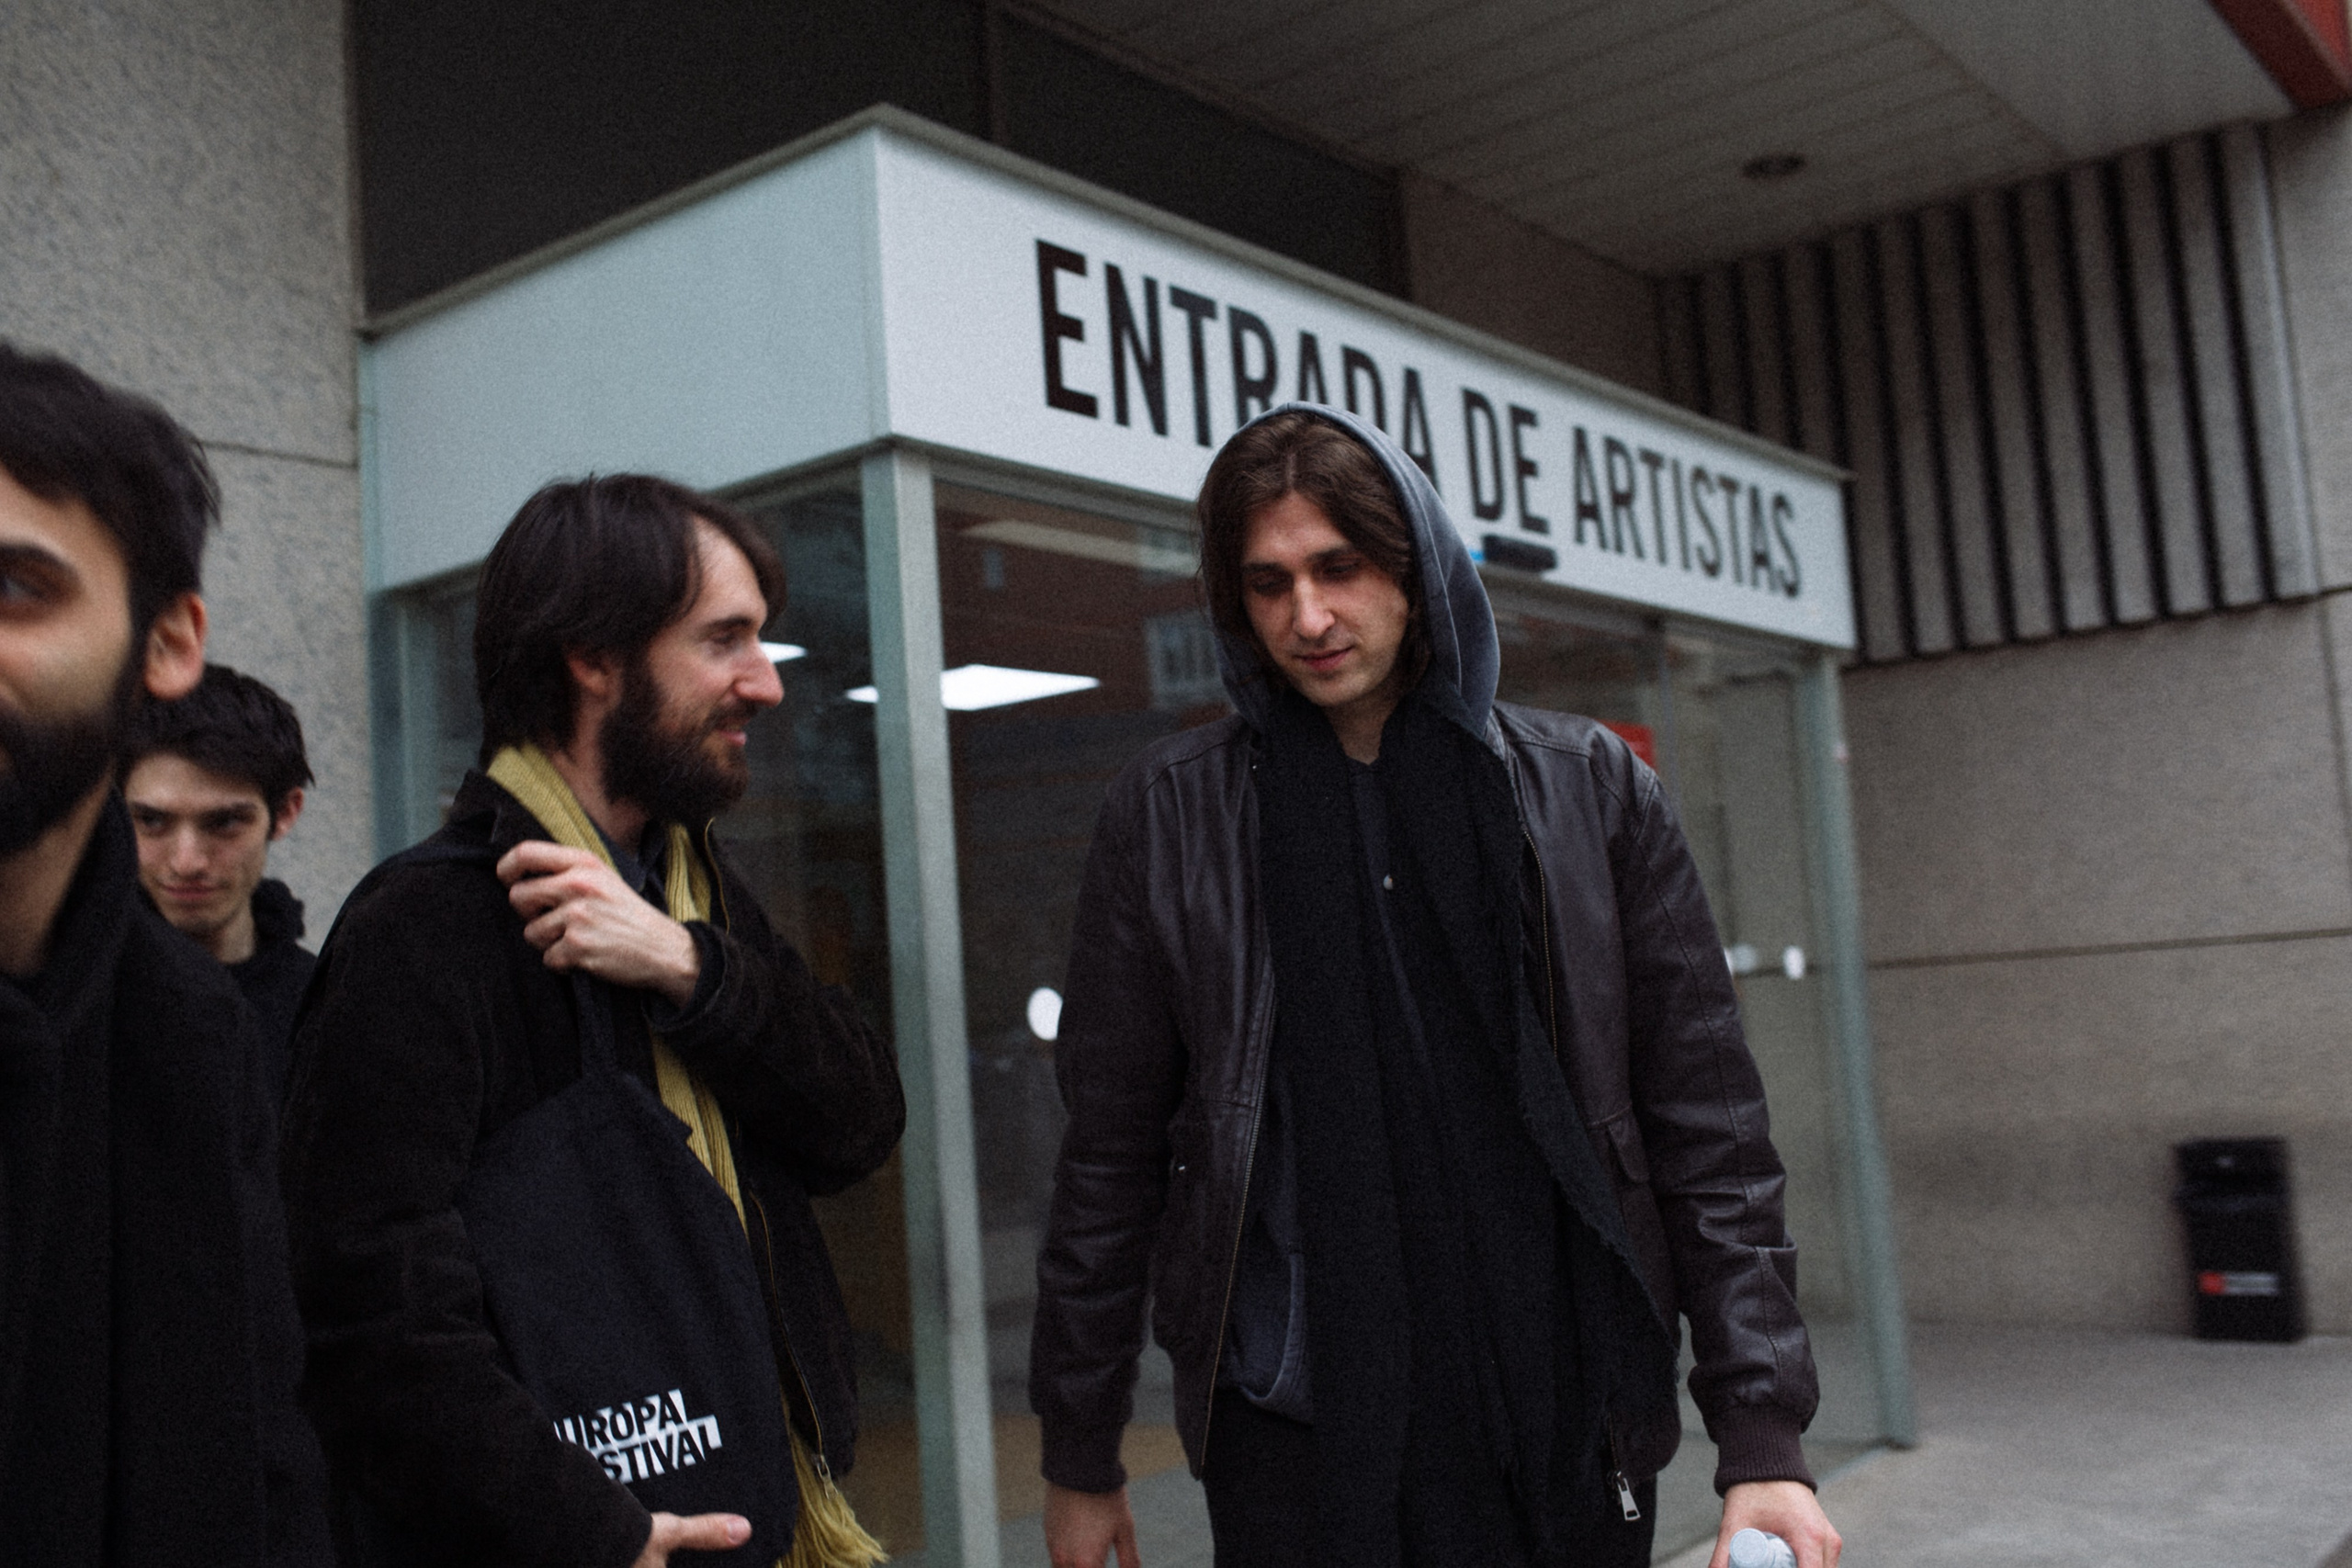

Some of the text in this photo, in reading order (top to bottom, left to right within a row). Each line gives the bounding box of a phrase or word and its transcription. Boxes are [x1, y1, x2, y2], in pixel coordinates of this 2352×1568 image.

[1461, 385, 1551, 536] DE
[1570, 425, 1803, 600] ARTISTAS
[553, 1389, 688, 1451] UROPA
[594, 1417, 723, 1484] STIVAL
